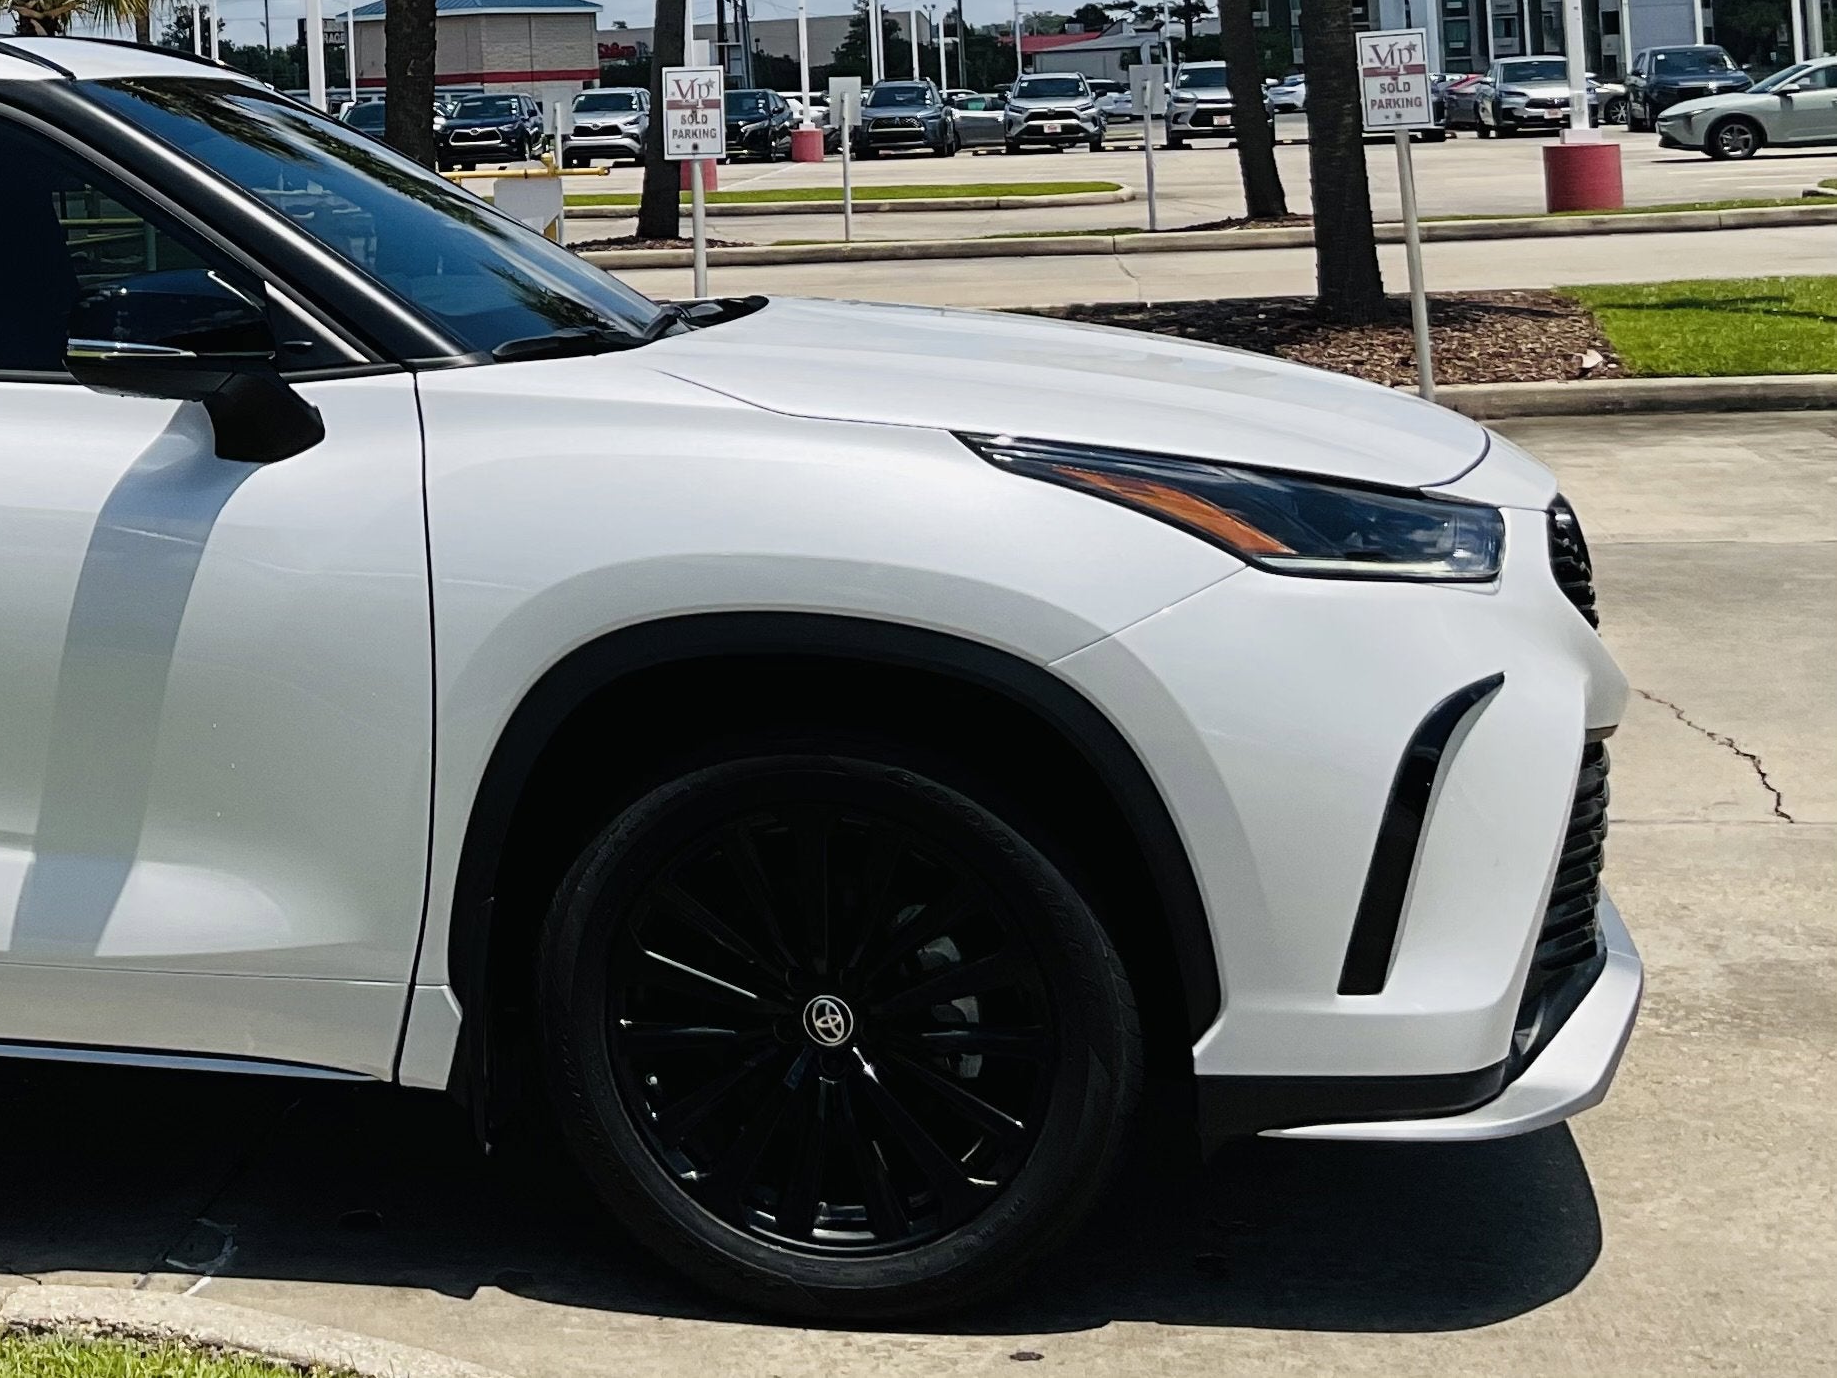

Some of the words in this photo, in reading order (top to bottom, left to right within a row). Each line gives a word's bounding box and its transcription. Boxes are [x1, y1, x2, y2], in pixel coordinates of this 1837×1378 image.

[1380, 81, 1411, 94] SOLD
[1370, 96, 1423, 110] PARKING
[680, 114, 708, 125] SOLD
[672, 128, 717, 139] PARKING
